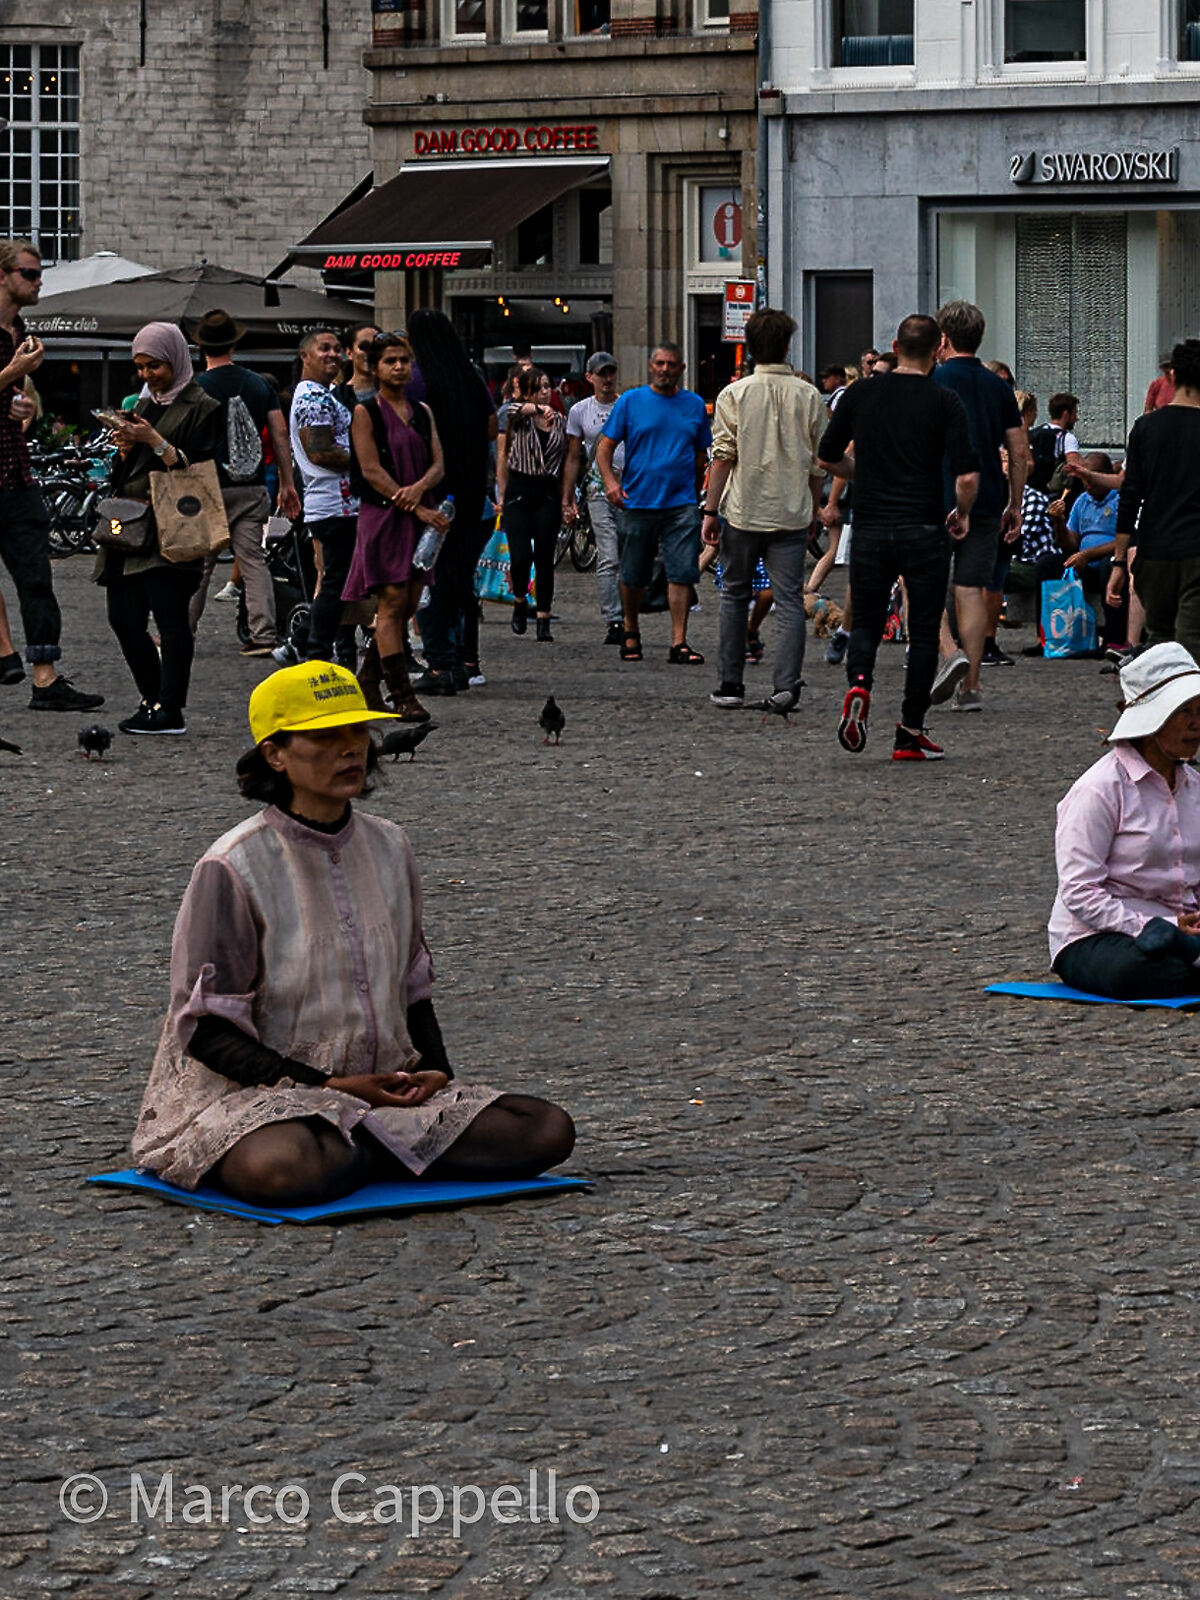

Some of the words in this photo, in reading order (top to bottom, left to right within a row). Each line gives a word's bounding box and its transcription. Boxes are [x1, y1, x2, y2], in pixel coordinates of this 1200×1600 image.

[414, 130, 457, 155] DAM
[461, 127, 520, 153] GOOD
[523, 125, 599, 150] COFFEE
[1041, 151, 1172, 182] SWAROVSKI
[324, 255, 357, 268] DAM
[360, 254, 402, 268] GOOD
[405, 252, 461, 267] COFFEE
[38, 317, 73, 331] coffee
[74, 317, 99, 331] club
[277, 321, 299, 334] the
